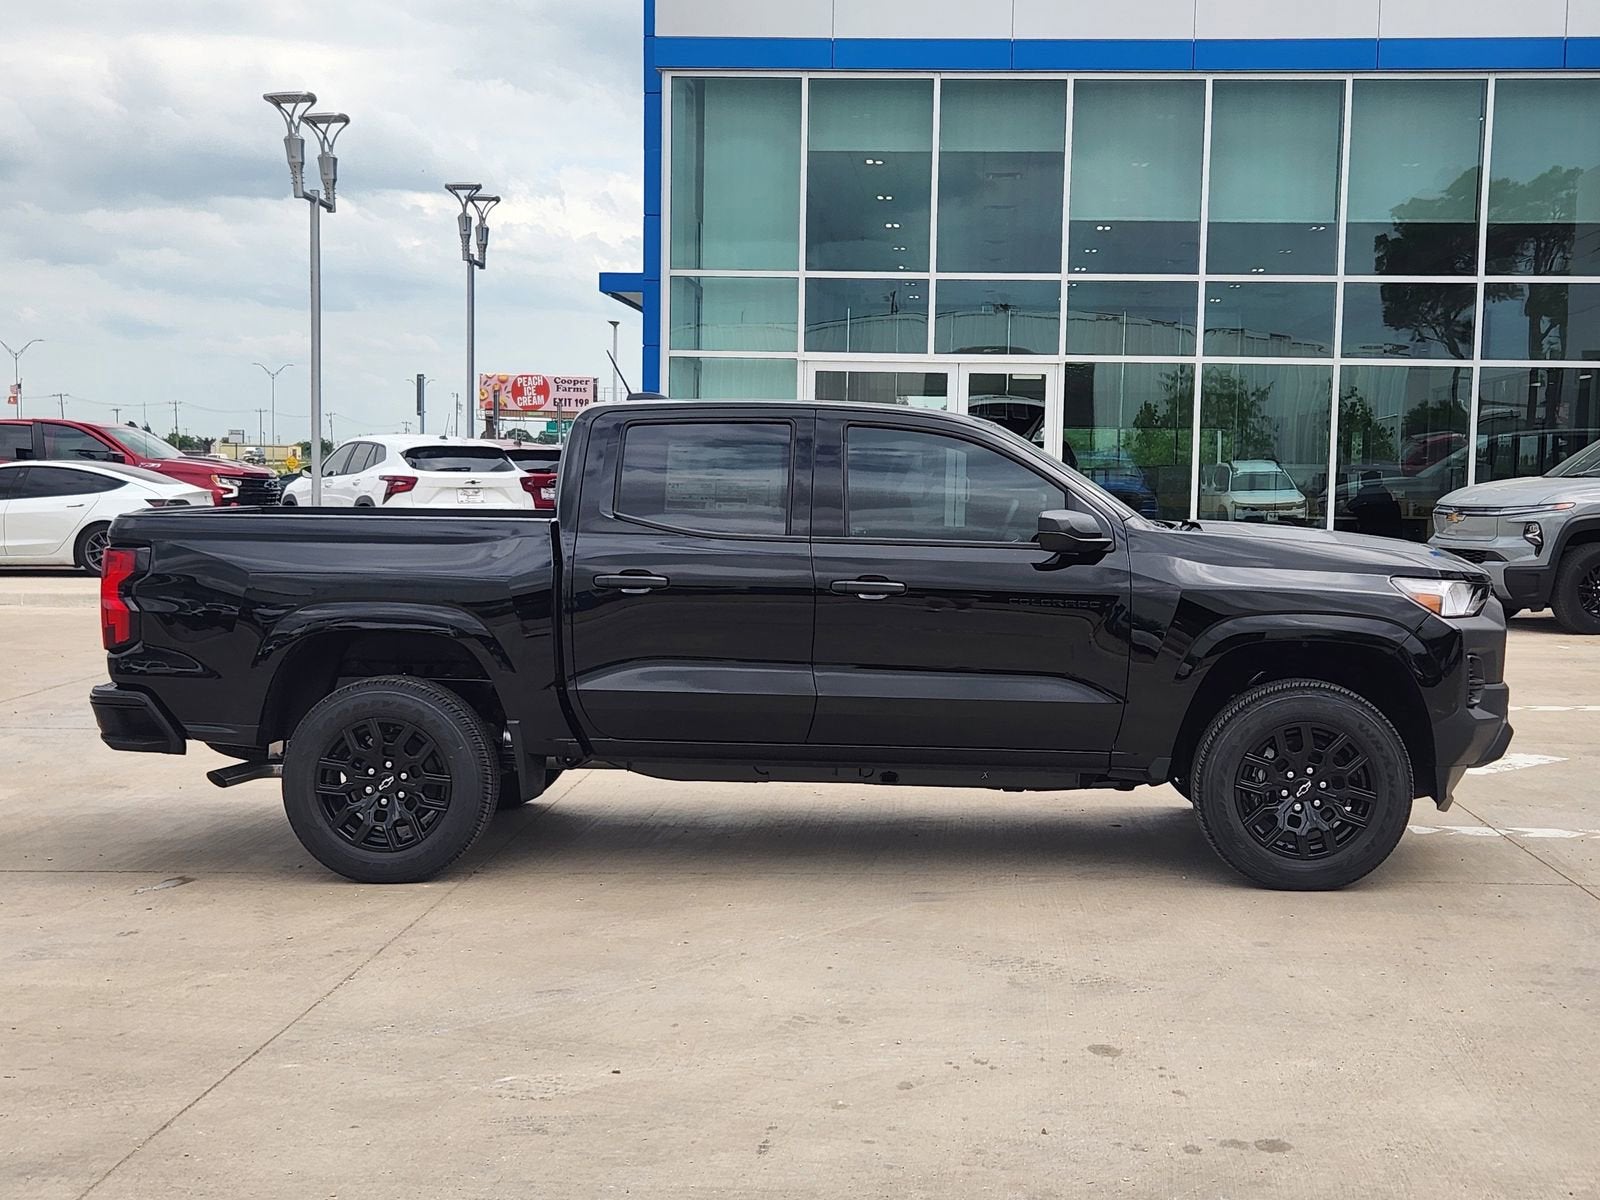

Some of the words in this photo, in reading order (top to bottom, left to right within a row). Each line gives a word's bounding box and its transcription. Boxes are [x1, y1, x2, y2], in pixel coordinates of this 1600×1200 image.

[517, 376, 543, 387] PEACH
[553, 377, 590, 386] Cooper
[524, 386, 536, 396] ICE
[556, 385, 587, 393] Farms
[517, 396, 544, 407] CREAM
[553, 397, 572, 407] EXIT
